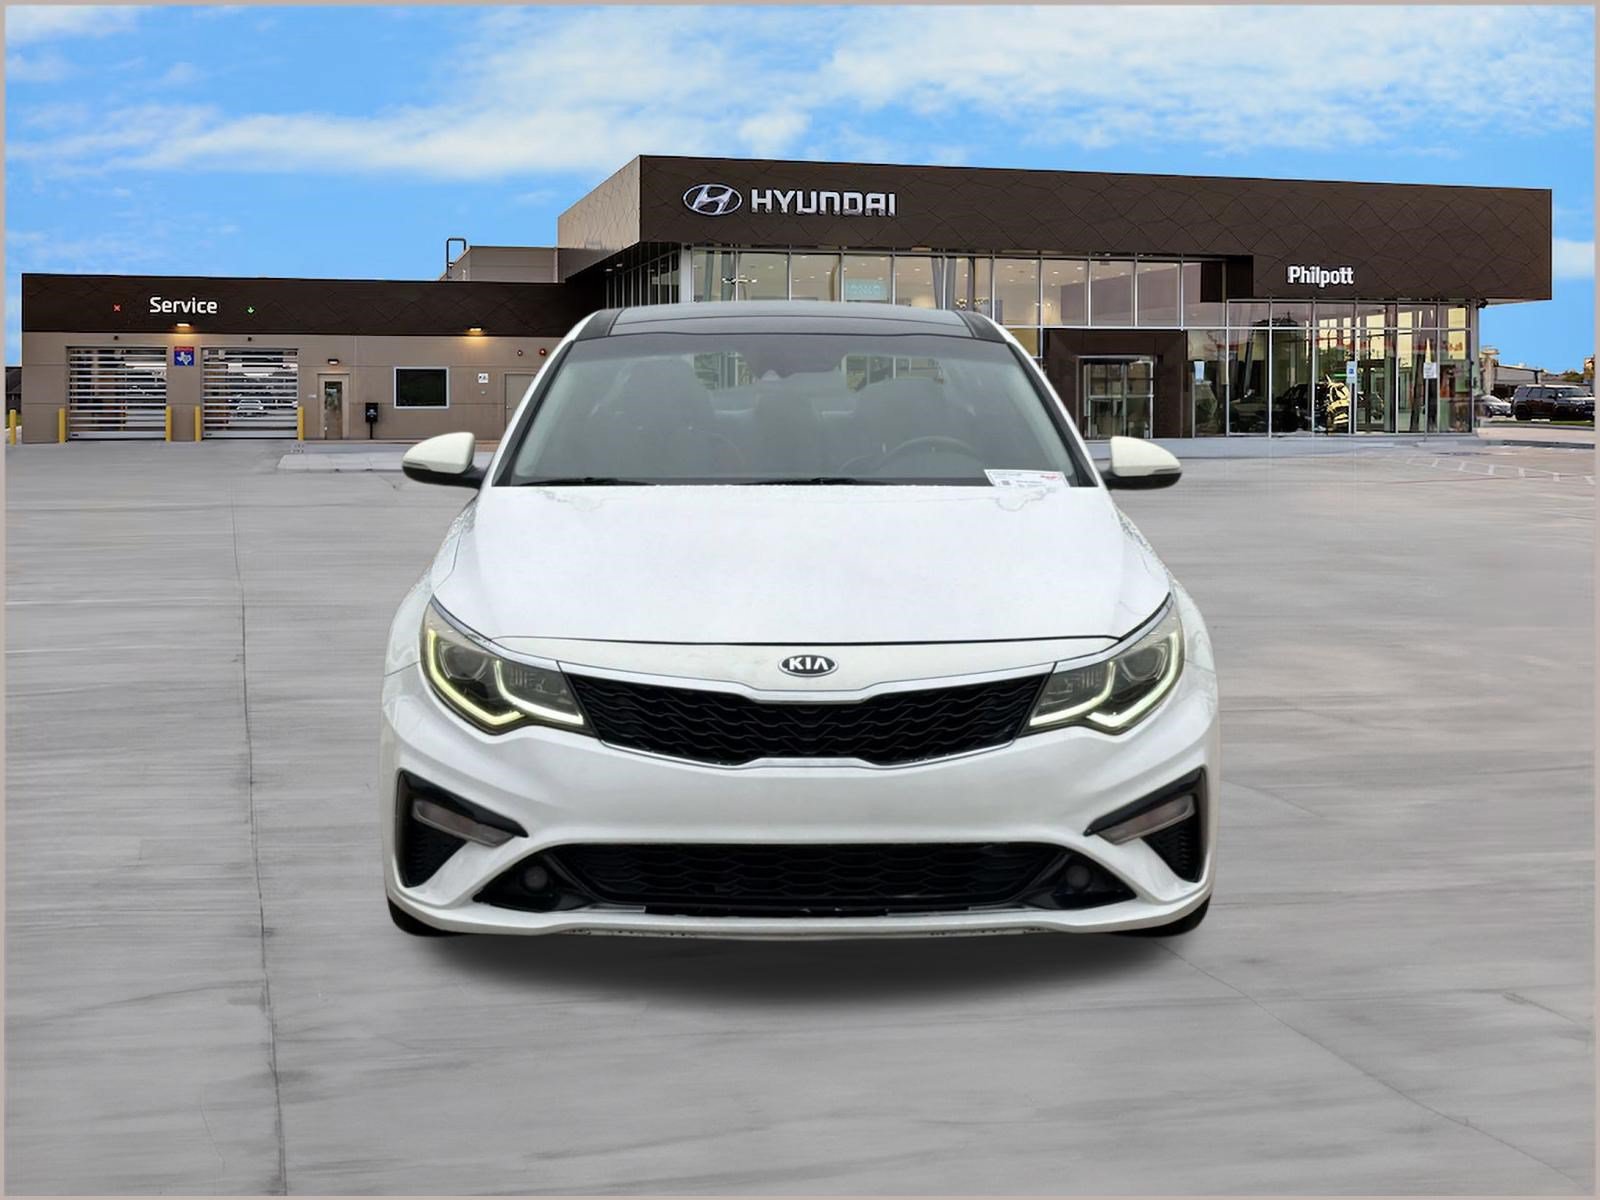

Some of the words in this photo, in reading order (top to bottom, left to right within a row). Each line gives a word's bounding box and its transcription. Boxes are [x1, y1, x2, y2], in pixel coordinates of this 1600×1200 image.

[751, 189, 896, 216] HYUNDAI
[1287, 265, 1354, 288] Philpott
[149, 296, 218, 314] Service
[789, 657, 829, 670] KIA
